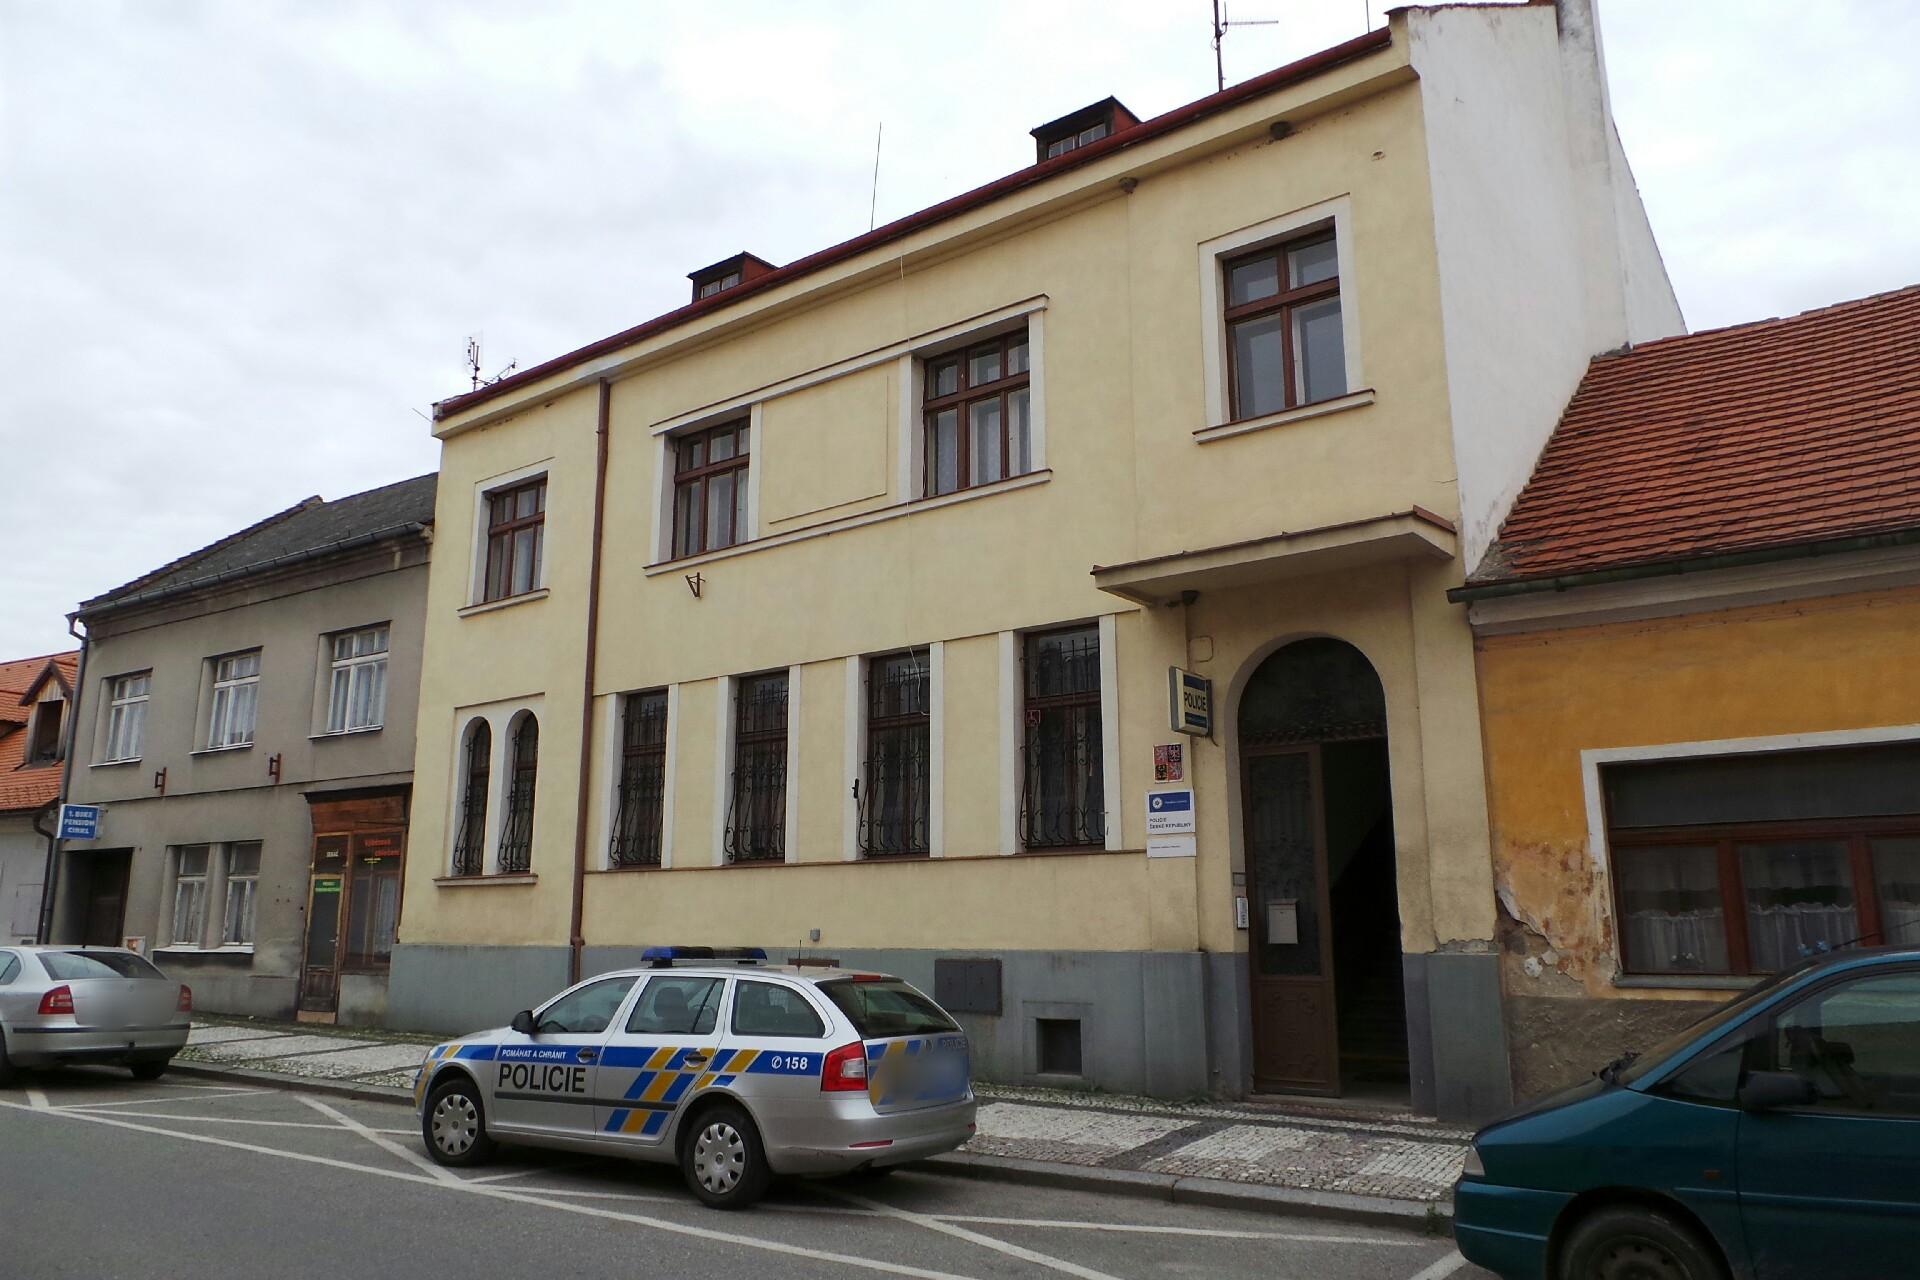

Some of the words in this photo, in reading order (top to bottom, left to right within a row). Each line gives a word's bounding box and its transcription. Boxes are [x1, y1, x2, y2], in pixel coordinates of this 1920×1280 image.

[1183, 691, 1207, 712] POLICIE
[64, 818, 96, 826] PENSION
[502, 1048, 532, 1057] POMÁHAT
[532, 1050, 538, 1058] A
[538, 1049, 567, 1059] CHRÁNIT
[785, 1056, 808, 1070] 158
[498, 1063, 586, 1093] POLICIE
